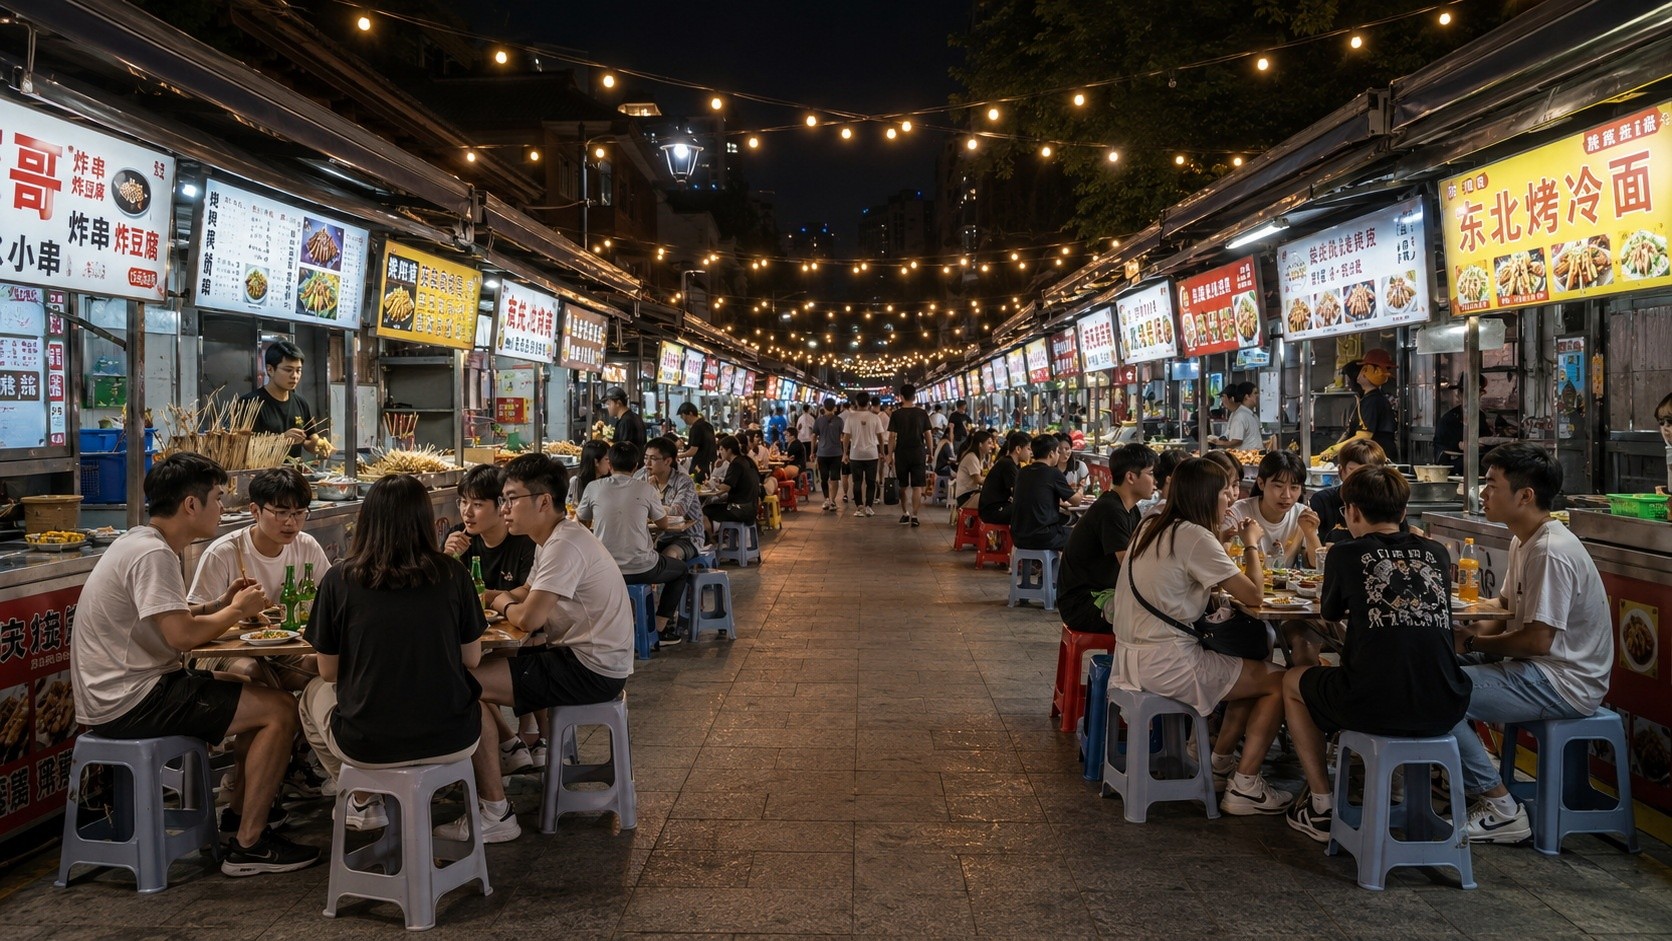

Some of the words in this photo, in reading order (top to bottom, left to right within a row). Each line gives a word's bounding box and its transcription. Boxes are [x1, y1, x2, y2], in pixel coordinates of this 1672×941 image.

[0, 129, 63, 220] 哥
[73, 150, 105, 179] 炸串
[68, 210, 109, 250] 炸串
[1458, 151, 1652, 252] 东北烤冷面
